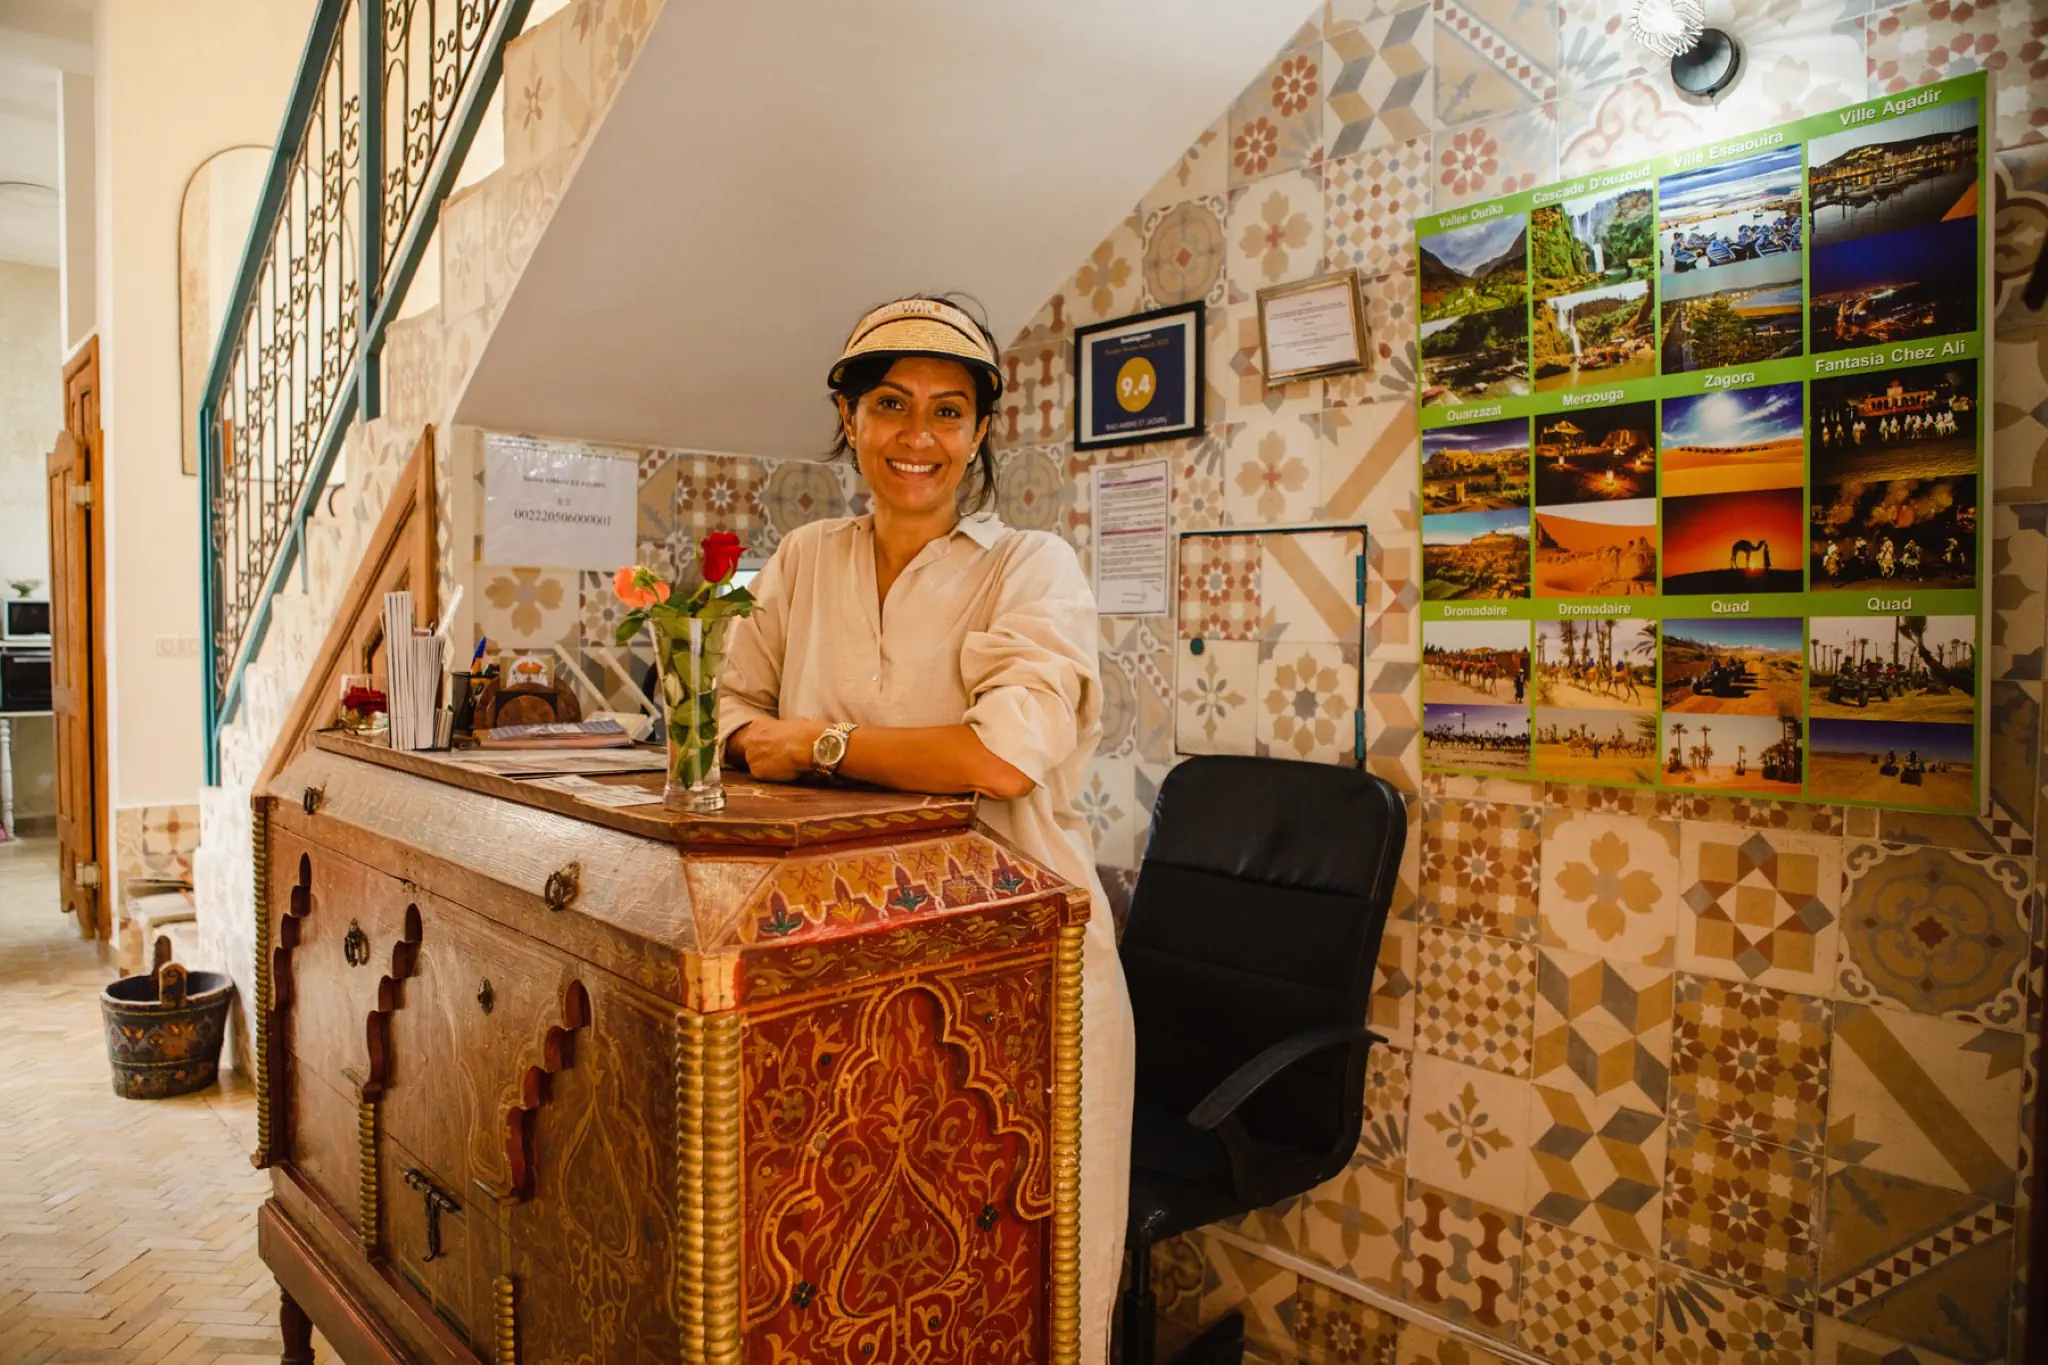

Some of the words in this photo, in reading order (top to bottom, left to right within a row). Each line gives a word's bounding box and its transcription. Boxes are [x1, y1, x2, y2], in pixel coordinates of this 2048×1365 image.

[1839, 108, 1876, 127] Ville
[1882, 88, 1943, 117] Agadir
[1673, 152, 1704, 170] Ville
[1709, 131, 1784, 161] Essaouira
[1532, 184, 1586, 205] Cascade
[1589, 165, 1651, 189] D'ouzoud
[1471, 203, 1504, 220] Ourika
[1815, 353, 1885, 374] Fantasia
[1891, 346, 1936, 364] Chez
[1940, 339, 1967, 356] Ali
[1120, 373, 1152, 398] 9.4
[1703, 370, 1756, 390] Zagora
[1562, 388, 1625, 407] Merzouga
[1446, 404, 1503, 422] Ouarzazat
[1443, 605, 1508, 617] Dromadaire
[1558, 603, 1631, 616] Dromadaire
[1711, 600, 1751, 614] Quad
[1866, 597, 1913, 612] Quad
